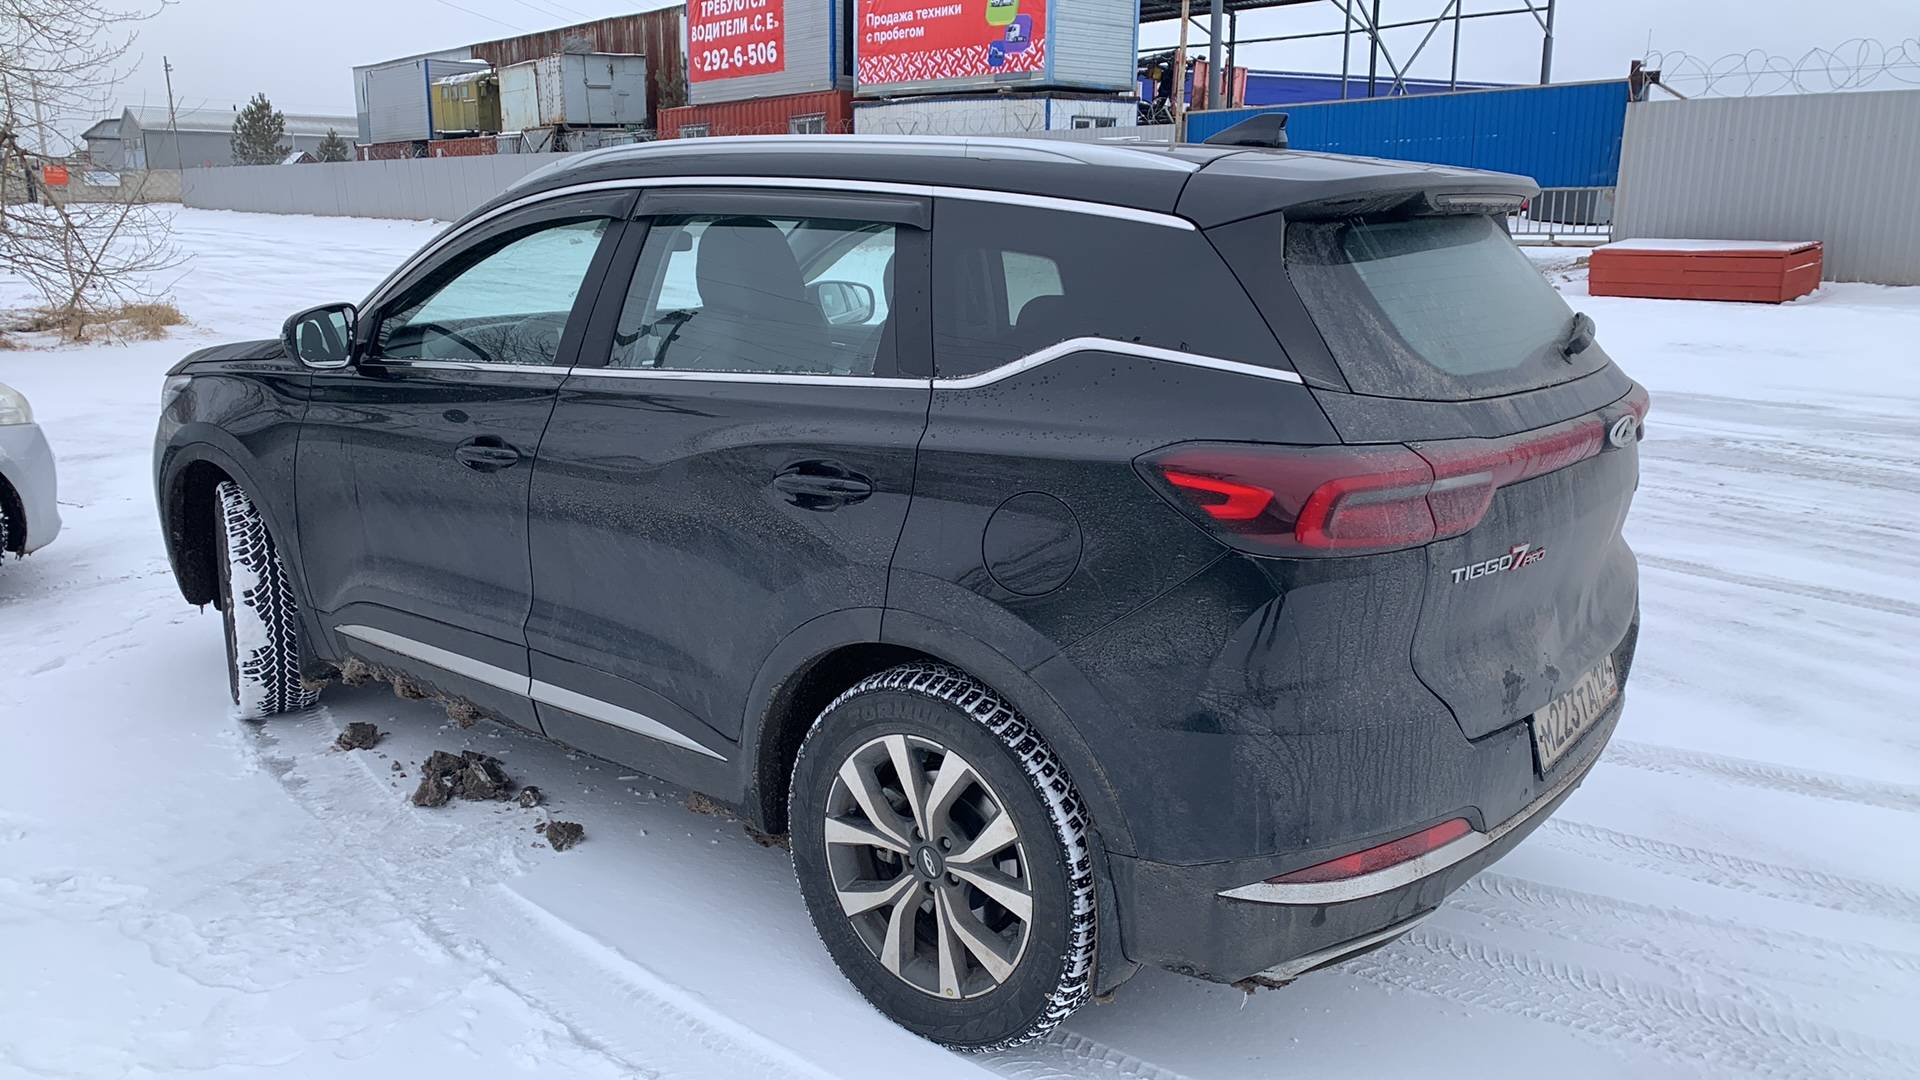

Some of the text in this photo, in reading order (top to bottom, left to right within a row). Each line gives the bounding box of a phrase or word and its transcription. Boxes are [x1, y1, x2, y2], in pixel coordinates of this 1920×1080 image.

[691, 16, 748, 42] ВОДИТЕЛИ
[866, 4, 962, 29] Продажа техники
[866, 26, 925, 44] с пробегом
[702, 40, 777, 72] 292-6-506
[1451, 554, 1512, 584] TIGGO
